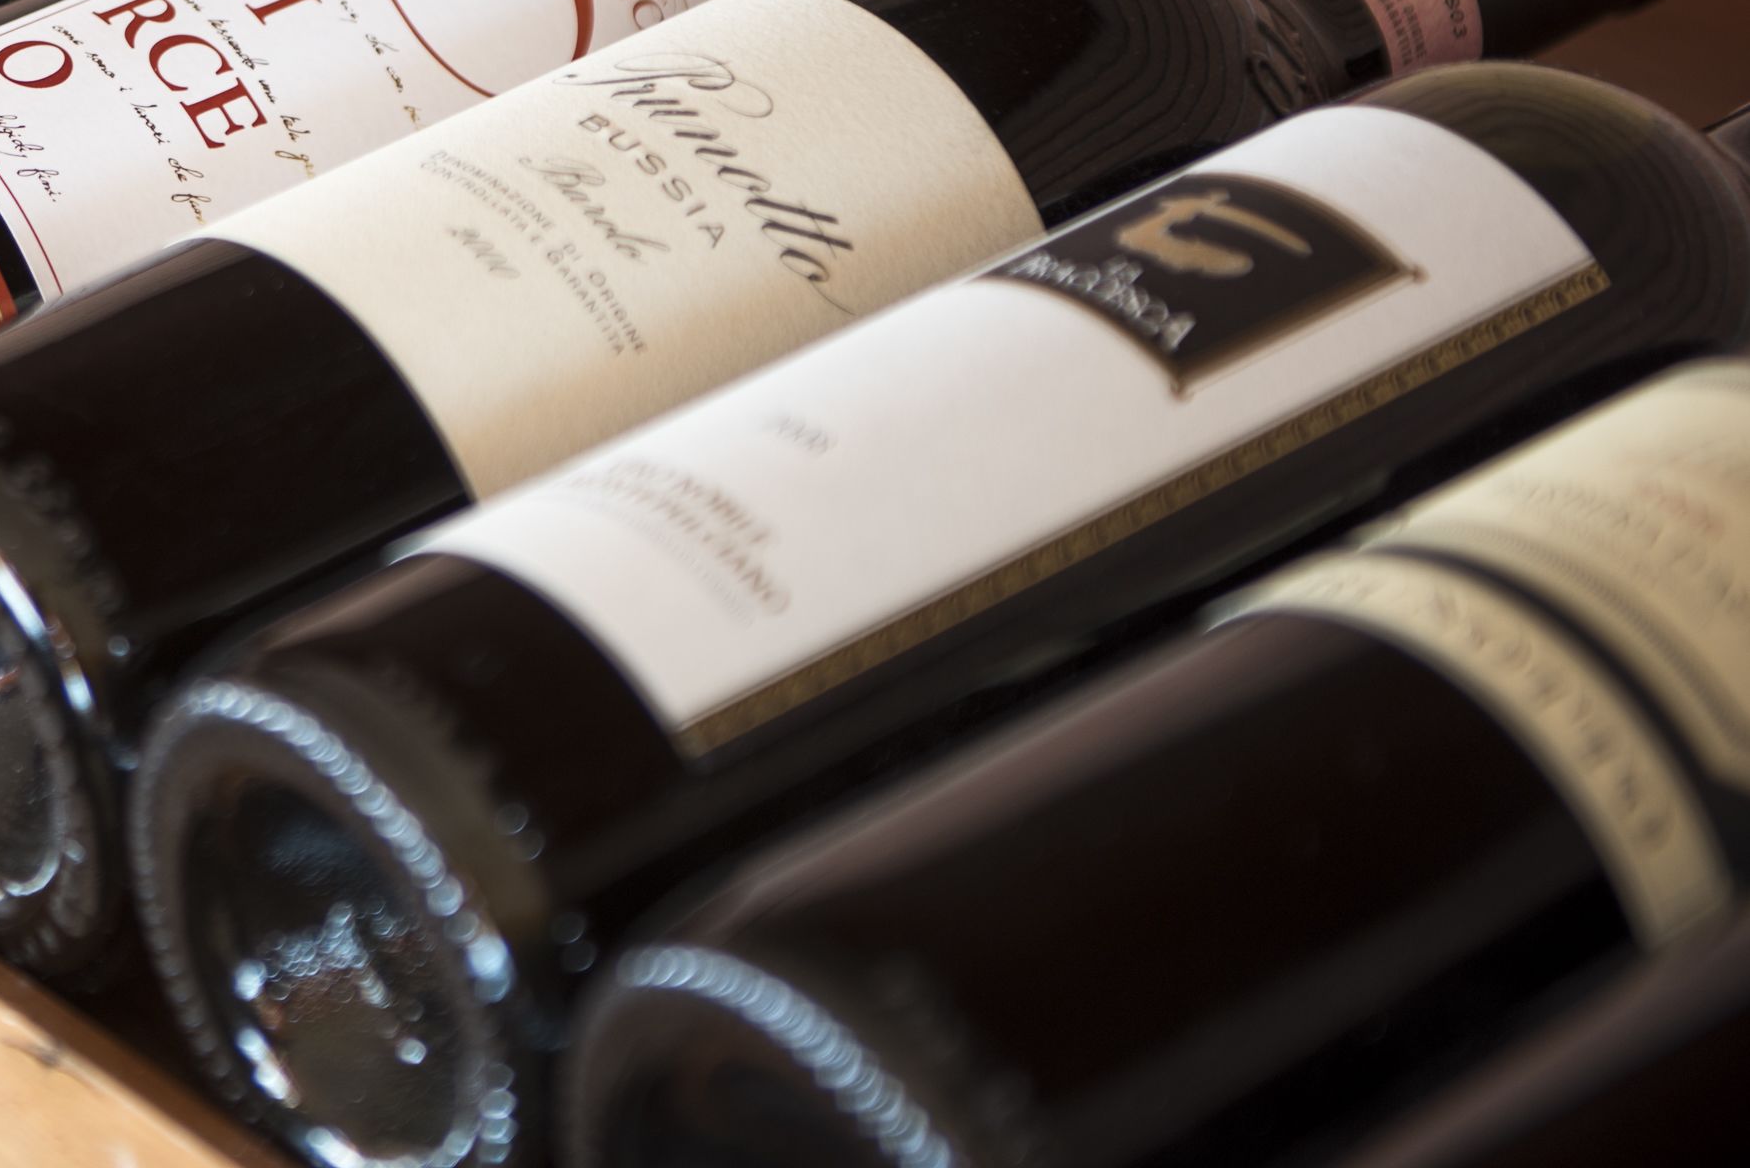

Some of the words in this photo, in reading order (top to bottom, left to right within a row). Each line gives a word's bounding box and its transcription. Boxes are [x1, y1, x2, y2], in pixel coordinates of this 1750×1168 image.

[51, 24, 85, 47] come
[84, 50, 117, 80] sono
[130, 102, 171, 146] lavori
[167, 156, 205, 184] che
[207, 18, 271, 71] tessendo
[258, 78, 277, 106] una
[279, 114, 312, 144] tela
[16, 167, 63, 203] fini.
[430, 148, 556, 230] DENOMINAZIONE
[588, 269, 648, 353] ORIGINE
[517, 154, 672, 265] Barolo
[553, 52, 857, 316] Prunotto
[578, 113, 726, 249] BUSSIA
[420, 160, 530, 233] CONTROLLATA
[546, 248, 625, 356] GARANTITA
